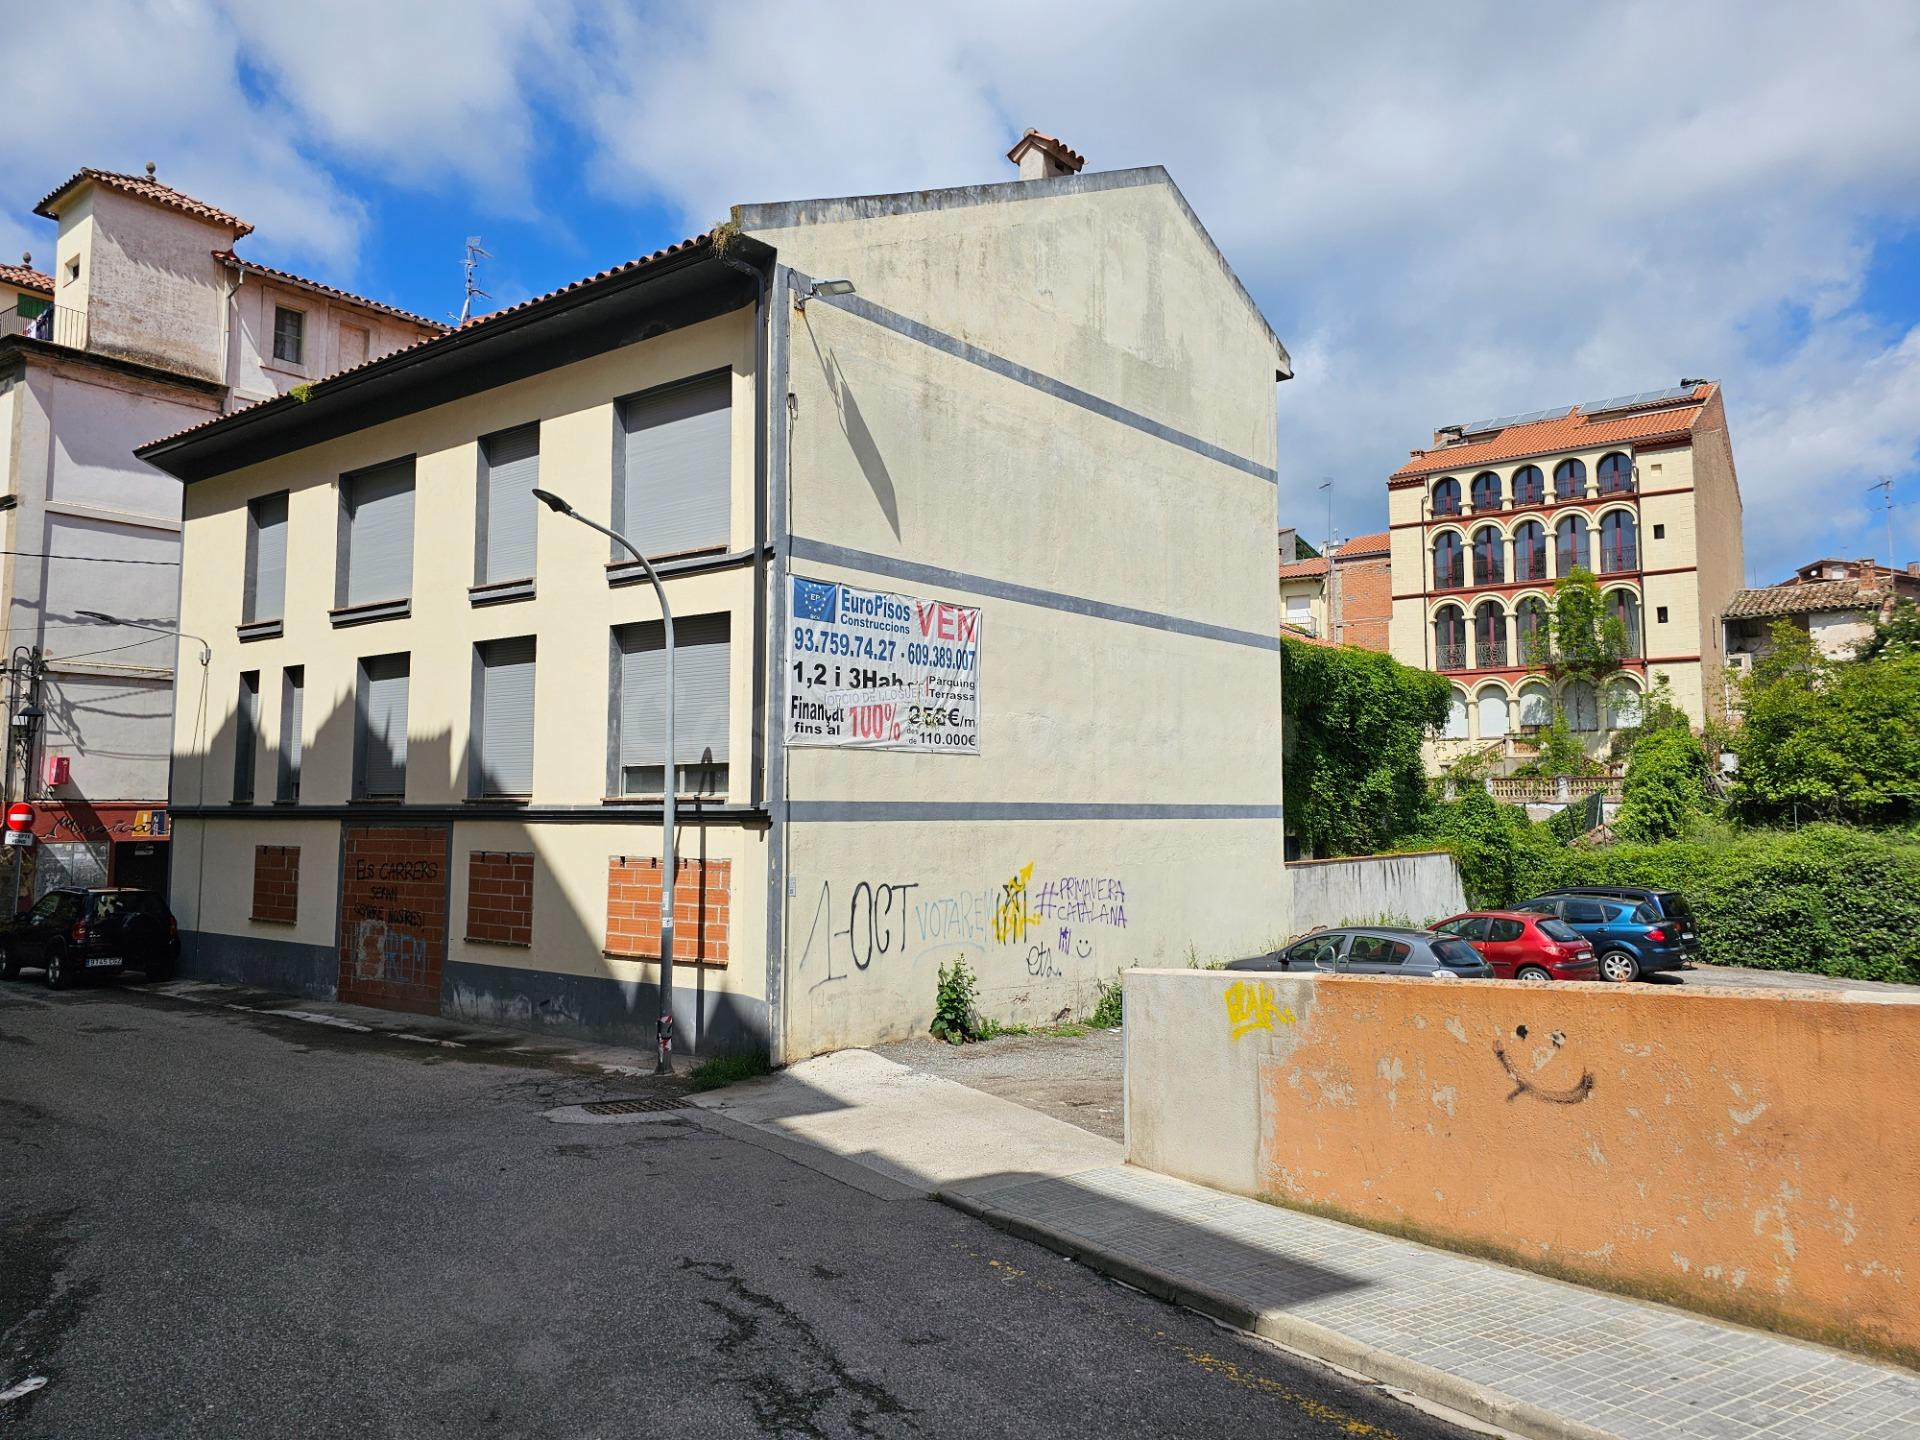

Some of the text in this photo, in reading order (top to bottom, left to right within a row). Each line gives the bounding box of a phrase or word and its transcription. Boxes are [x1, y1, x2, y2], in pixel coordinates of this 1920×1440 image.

[842, 589, 910, 621] EuroPisos
[840, 614, 910, 635] Construccions
[794, 627, 896, 662] 93.759.74.27
[908, 641, 976, 671] 609.389.007
[835, 666, 841, 687] i
[929, 689, 976, 702] Terrassa
[794, 721, 841, 736] fins al
[849, 703, 901, 742] 100%
[920, 732, 976, 747] 110.000€
[379, 861, 438, 881] CARRERS
[1058, 900, 1127, 928] CATALANA
